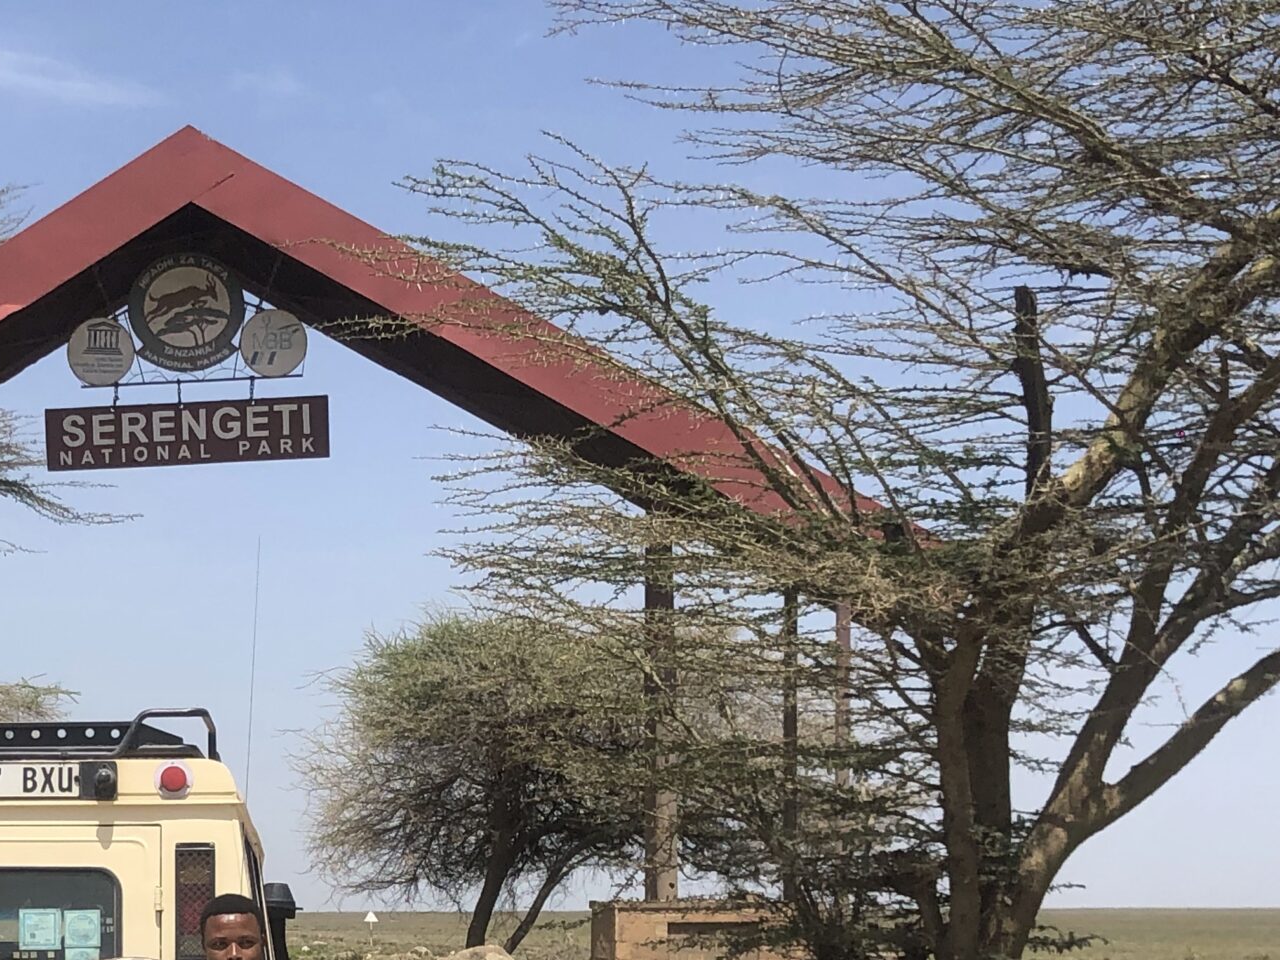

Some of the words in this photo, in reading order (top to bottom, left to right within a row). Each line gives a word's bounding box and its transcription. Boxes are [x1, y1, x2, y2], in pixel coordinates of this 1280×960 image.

[144, 350, 194, 369] NATIONAL
[196, 348, 231, 367] PARKS
[62, 403, 311, 447] SERENGETI
[59, 443, 211, 466] NATIONAL
[238, 437, 315, 456] PARK
[22, 767, 73, 793] BXU
